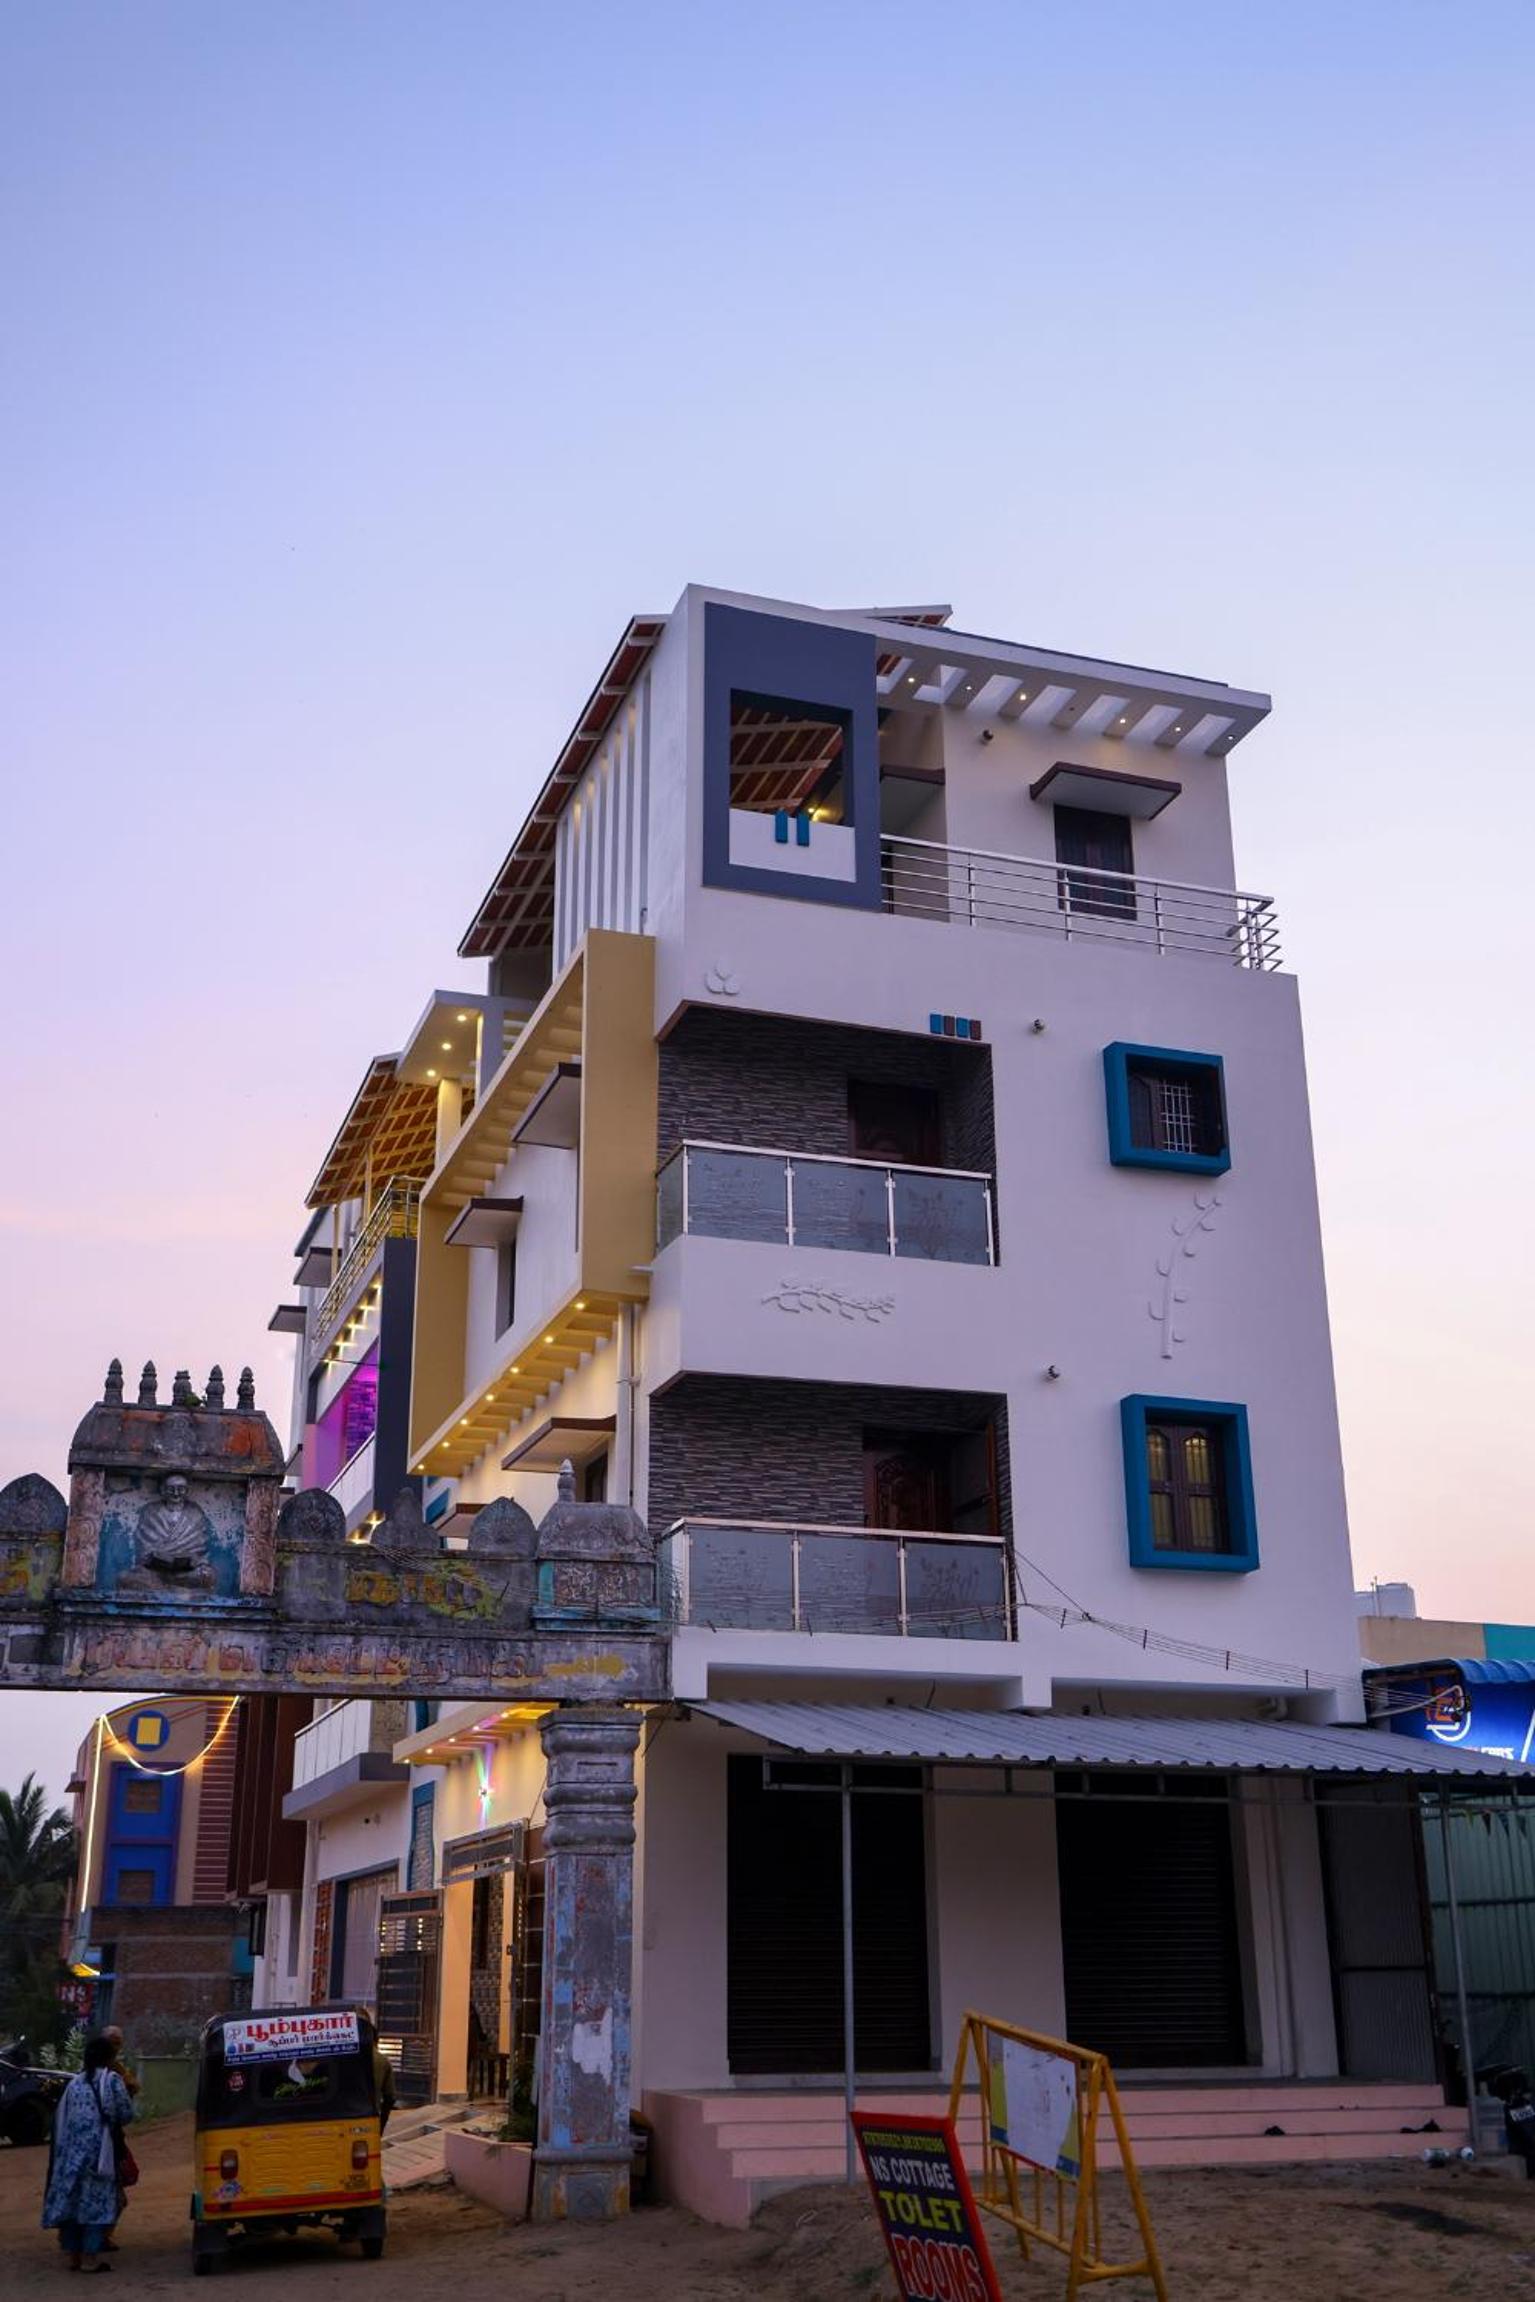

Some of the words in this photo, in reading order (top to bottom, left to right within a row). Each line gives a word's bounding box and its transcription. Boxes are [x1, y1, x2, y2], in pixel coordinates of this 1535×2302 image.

[247, 2012, 353, 2042] பூம்புகார்
[870, 2156, 890, 2181] NS
[890, 2157, 955, 2190] COTTAGE
[878, 2190, 964, 2233] TOLET
[891, 2233, 988, 2302] ROOMS
